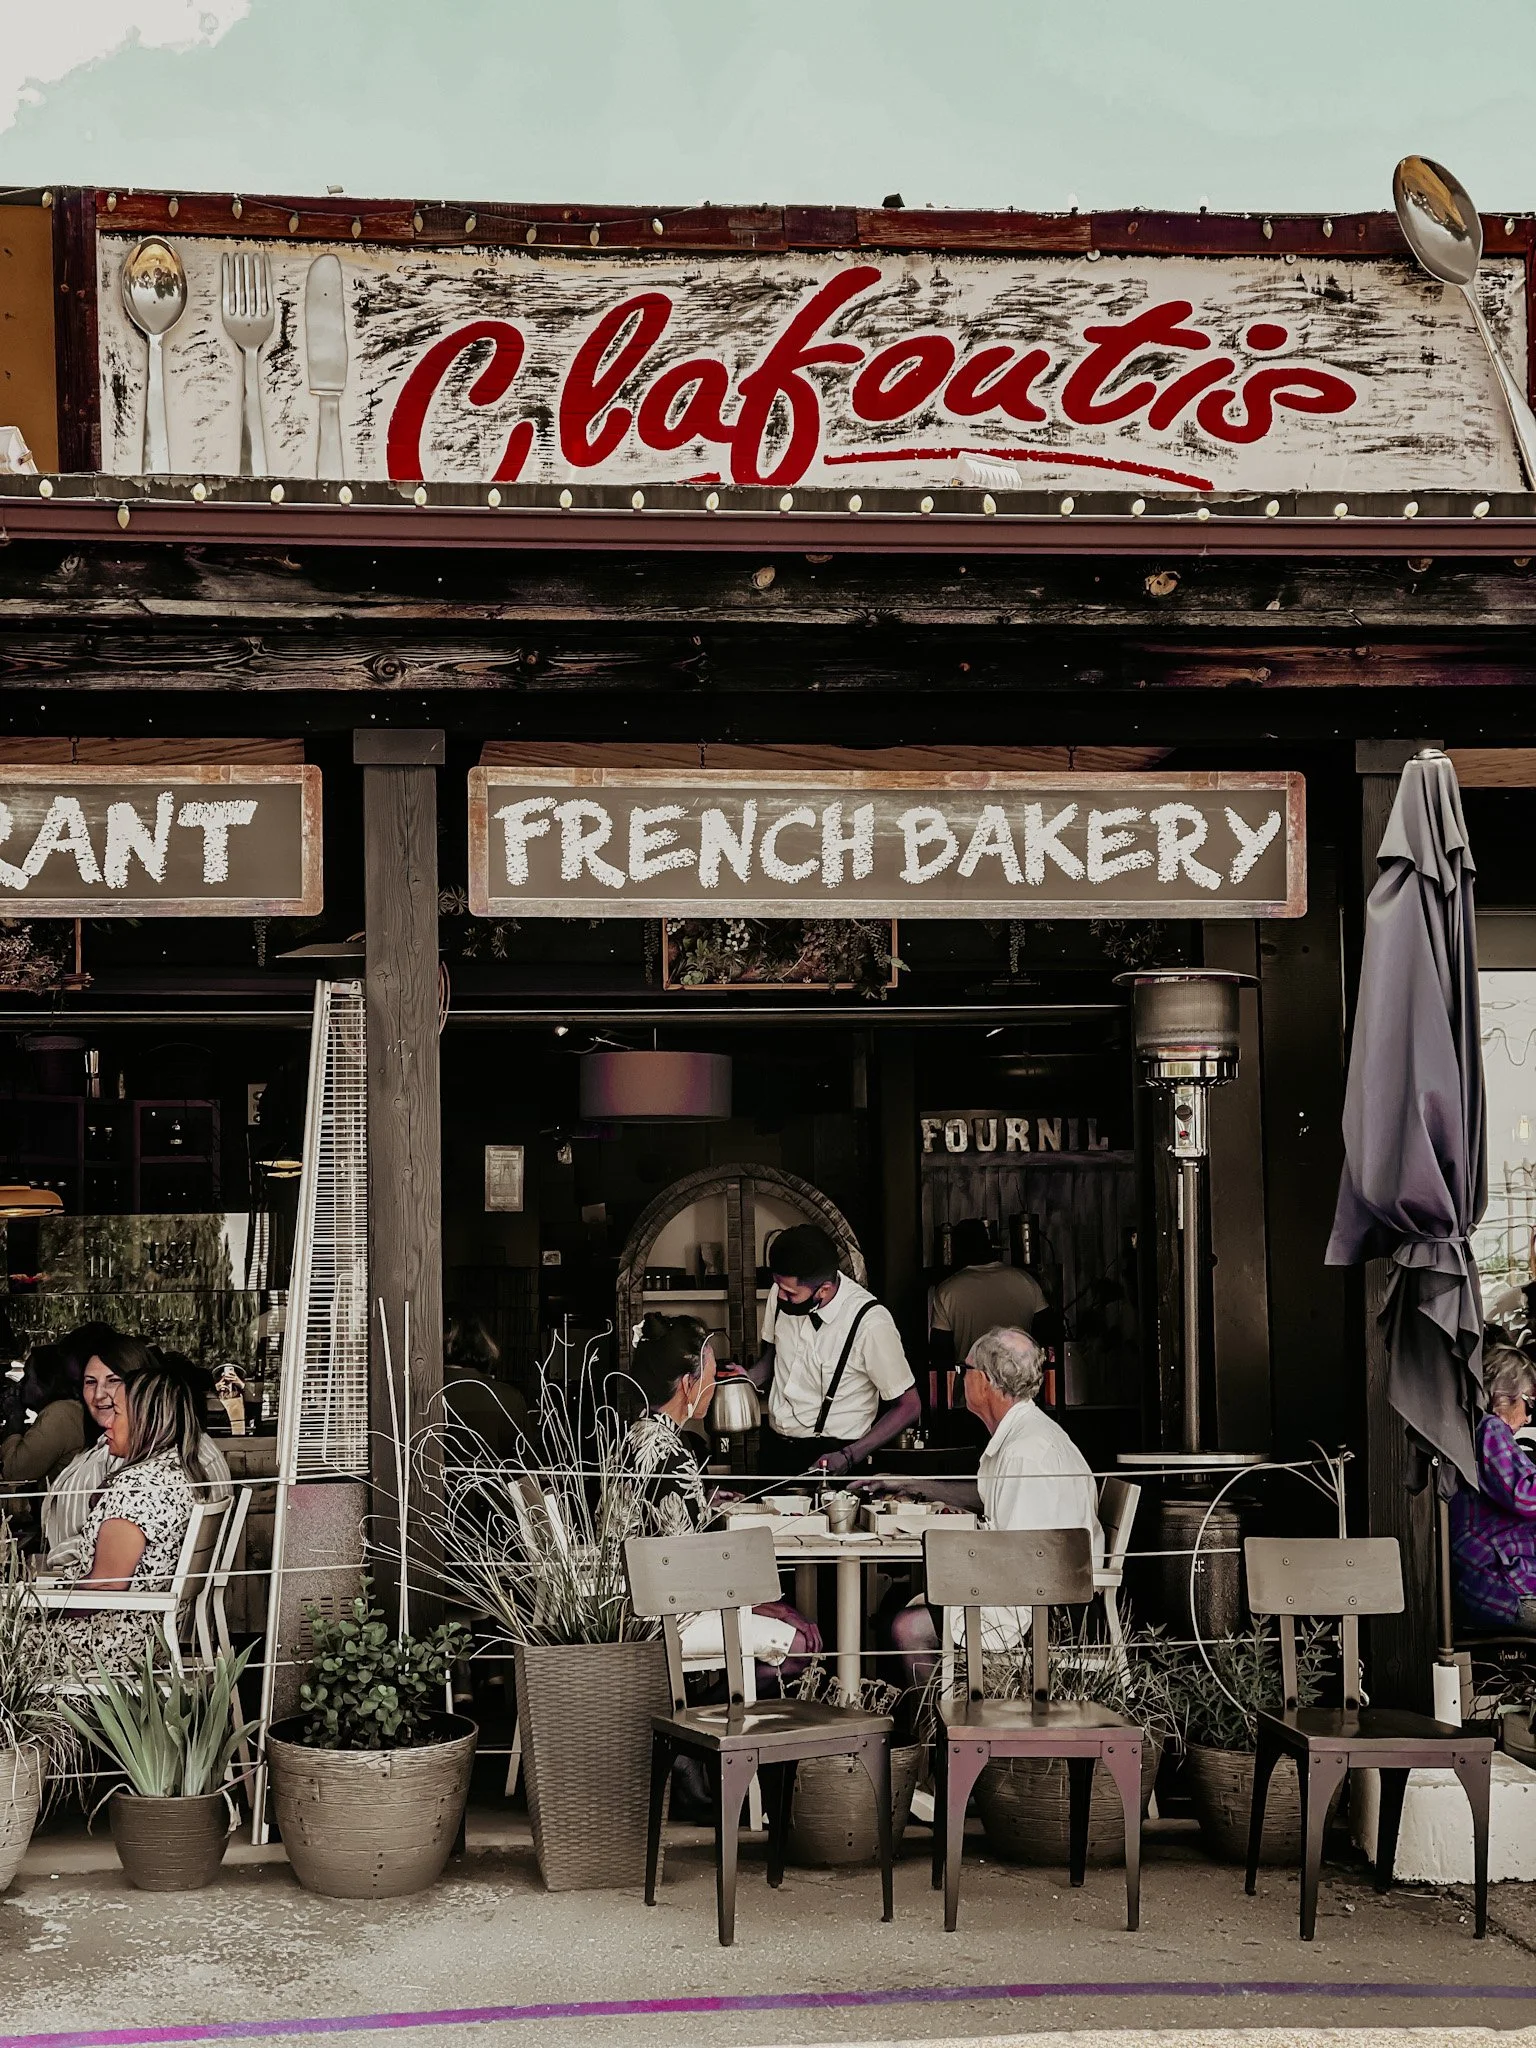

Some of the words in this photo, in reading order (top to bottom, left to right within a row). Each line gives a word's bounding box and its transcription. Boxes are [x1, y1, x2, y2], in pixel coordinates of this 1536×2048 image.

[388, 266, 1357, 486] Clafoutis
[494, 796, 875, 889] FRENCH
[899, 802, 1281, 891] BAKERY
[920, 1117, 1109, 1153] FOURNIL
